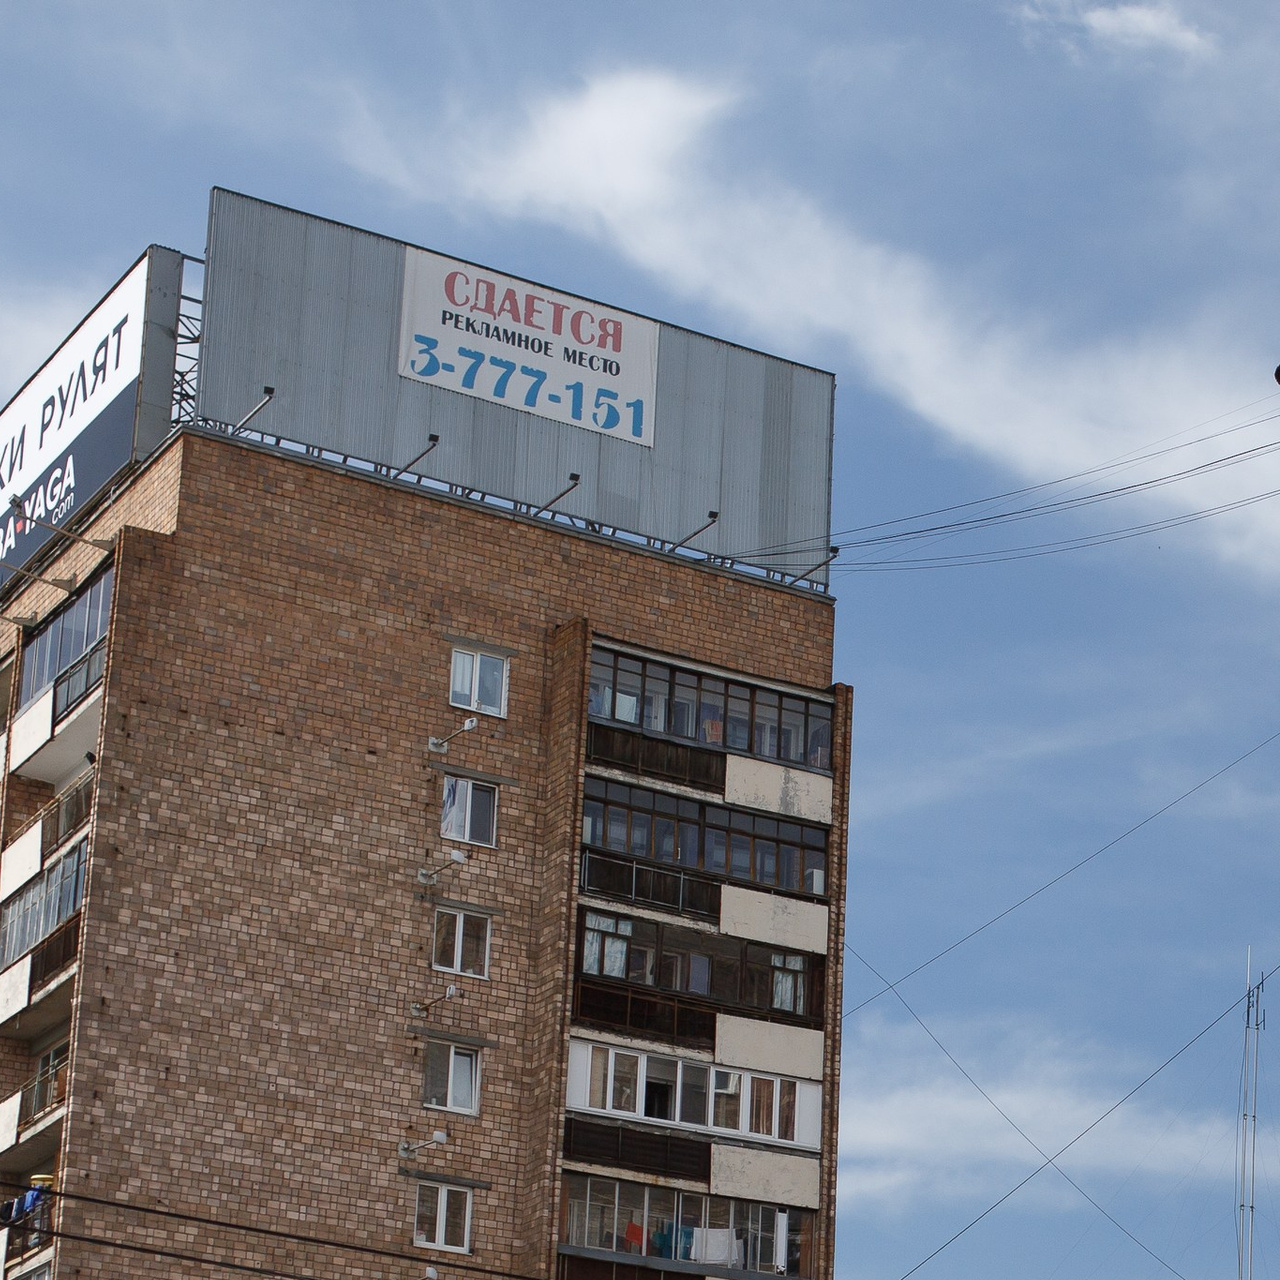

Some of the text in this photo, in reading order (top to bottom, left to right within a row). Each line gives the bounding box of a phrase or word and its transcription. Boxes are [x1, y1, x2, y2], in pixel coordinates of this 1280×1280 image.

[441, 310, 621, 377] РЕКЛАМНОЕ МЕСТО
[444, 271, 623, 353] СДАЕТСЯ
[39, 313, 129, 451] РУЛЯТ
[410, 334, 645, 438] 3-777-151
